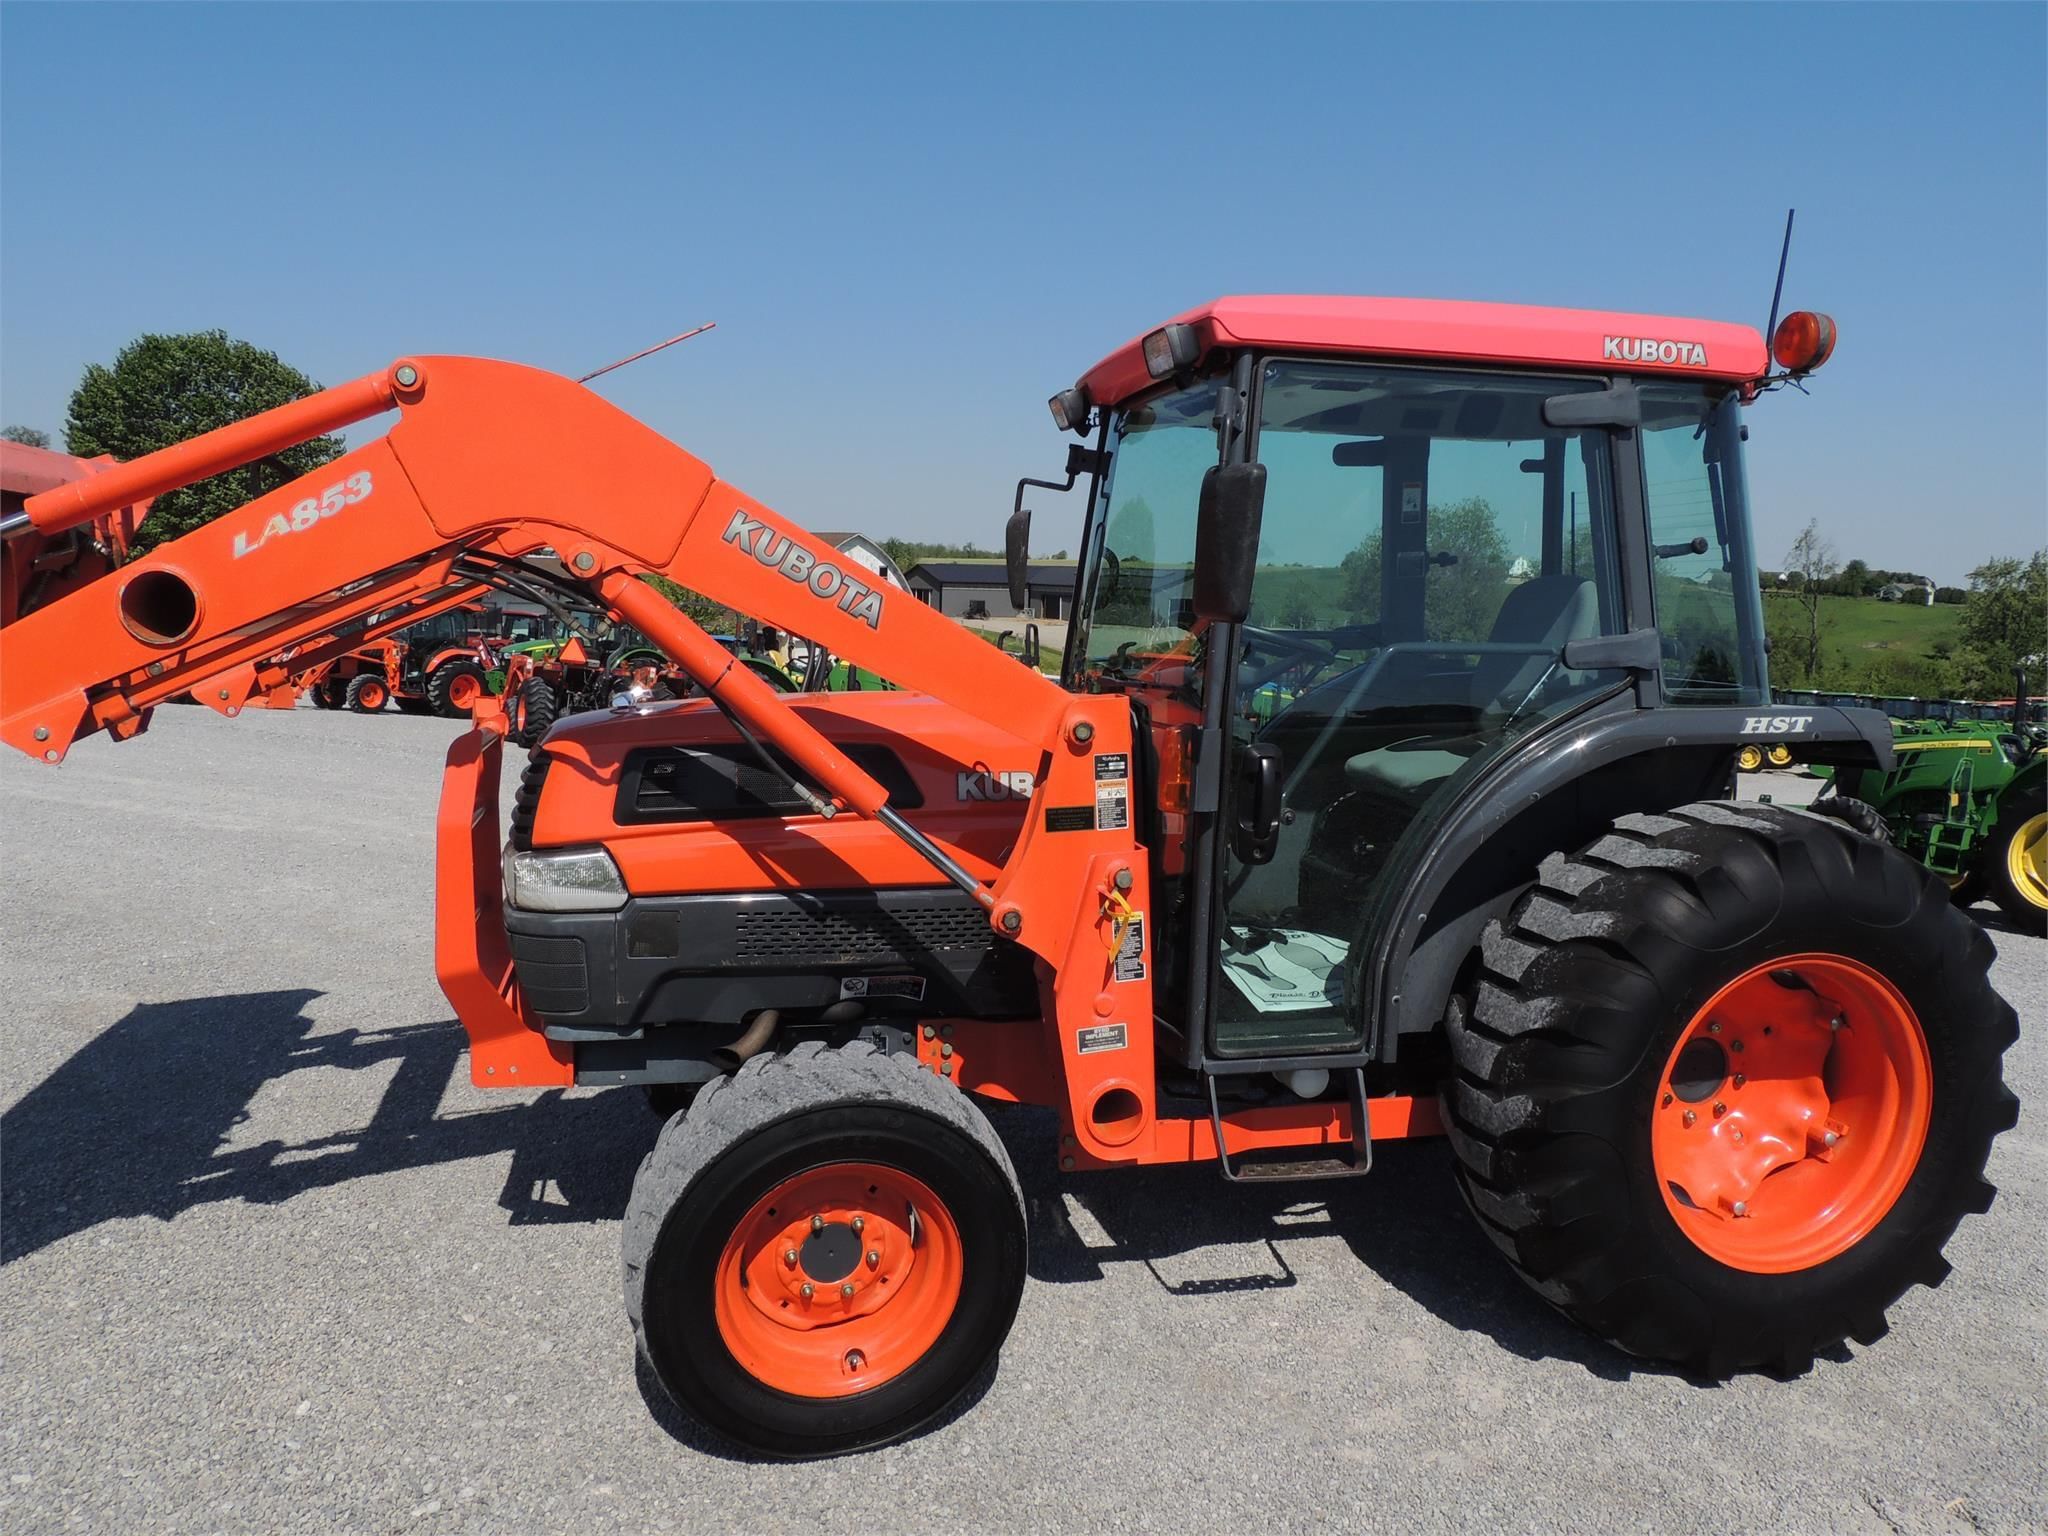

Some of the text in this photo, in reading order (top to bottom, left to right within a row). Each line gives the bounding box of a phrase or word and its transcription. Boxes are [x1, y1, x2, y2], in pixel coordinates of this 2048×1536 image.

[1604, 335, 1708, 366] KUBOTA
[234, 471, 372, 558] LA853
[722, 510, 884, 630] KUBOTA
[1740, 716, 1813, 735] HST
